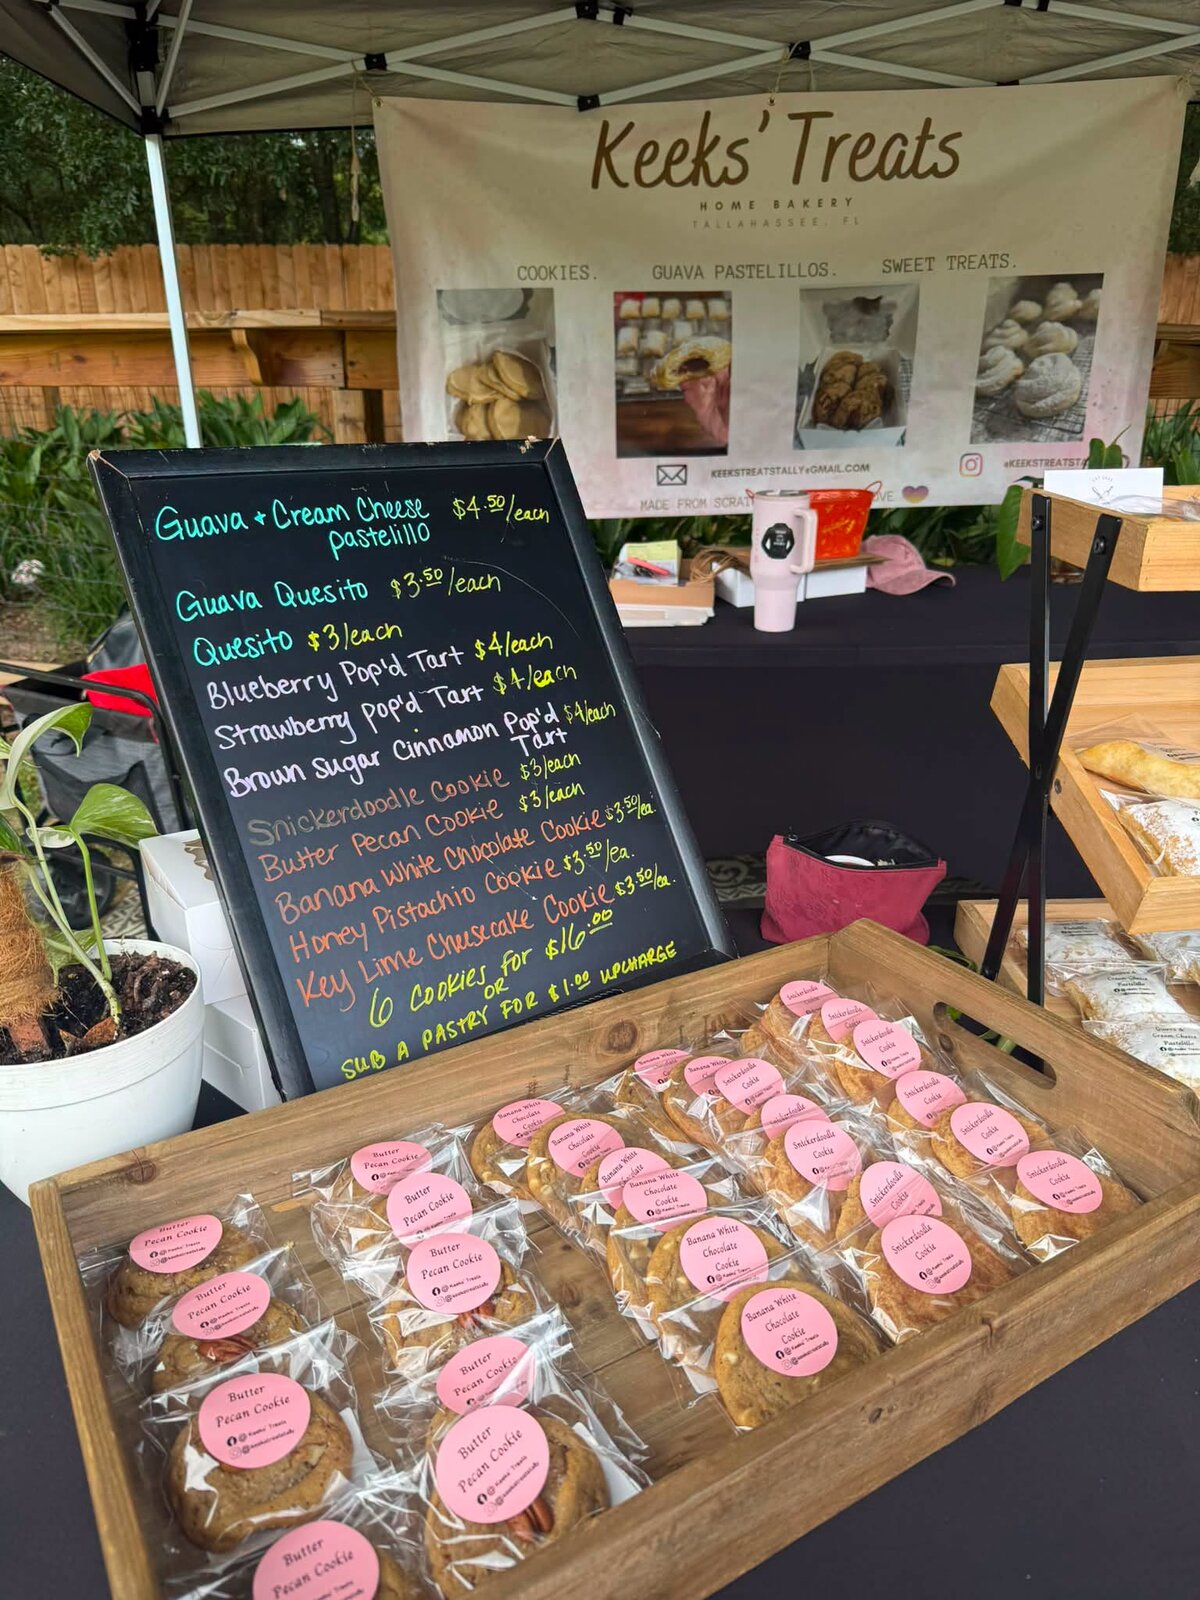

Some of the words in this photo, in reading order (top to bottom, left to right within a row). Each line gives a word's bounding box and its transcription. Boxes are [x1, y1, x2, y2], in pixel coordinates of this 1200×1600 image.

[591, 110, 769, 189] Keeks'
[787, 111, 963, 185] Treats
[700, 201, 755, 211] HOME
[773, 197, 853, 209] BAKERY
[842, 215, 860, 226] FL
[517, 265, 598, 281] COOKIES.
[652, 264, 704, 280] GUAVA
[714, 262, 837, 279] PASTELILLOS.
[882, 257, 935, 274] SWEET
[946, 253, 1017, 271] TREATS.
[640, 500, 670, 511] MADE
[677, 498, 707, 510] FROM
[155, 505, 248, 541] Guava
[272, 496, 352, 530] Cream
[356, 495, 431, 521] Cheese
[175, 589, 263, 623] Guava
[273, 577, 369, 608] Quesito
[193, 627, 294, 667] Quesito
[206, 673, 338, 711] Blueberry
[407, 645, 465, 671] Tart
[214, 711, 358, 750] Strawberry
[427, 684, 485, 709] Tart
[510, 727, 568, 756] Tart
[224, 763, 306, 799] Brown
[392, 721, 499, 762] Cinnamon
[247, 788, 423, 847] Snickerdoodle
[431, 767, 511, 803] Cookie
[258, 844, 340, 883] Butter
[351, 824, 422, 856] Pecan
[425, 798, 504, 836] Cookie
[275, 878, 381, 926] Banana
[381, 854, 443, 888] White
[443, 828, 536, 872] Chocolate
[540, 806, 607, 842] Cookie
[289, 920, 369, 963] Honey
[372, 886, 476, 936] Pistachio
[484, 857, 562, 895] Cookie
[296, 973, 356, 1013] Key
[357, 949, 424, 985] Lime
[426, 908, 535, 957] Cheesecake
[542, 883, 616, 925] Cookie
[368, 987, 394, 1029] 6
[410, 964, 487, 1013] Cookies
[484, 977, 509, 1001] OR
[340, 1052, 386, 1081] SUB
[396, 1040, 410, 1062] A
[421, 1003, 490, 1052] PASTRY
[501, 991, 539, 1020] FOR
[600, 941, 678, 985] UPCHARGE
[923, 1092, 942, 1105] Cookie
[497, 1108, 522, 1119] Banana
[522, 1101, 541, 1110] White
[511, 1110, 541, 1124] Chocolate
[551, 1131, 575, 1147] Banana
[574, 1121, 592, 1133] White
[567, 1132, 595, 1151] Chocolate
[792, 1129, 836, 1150] Snickerdoodle
[980, 1125, 999, 1140] Cookie
[363, 1160, 389, 1170] Pecan
[391, 1153, 420, 1165] Cookie
[372, 1148, 400, 1158] Butter
[581, 1144, 601, 1158] Cookie
[812, 1147, 834, 1159] Cookie
[601, 1163, 624, 1184] Banana
[1026, 1156, 1068, 1179] Snickerdoodle
[629, 1178, 657, 1188] Banana
[657, 1171, 680, 1181] White
[643, 1183, 678, 1196] Chocolate
[869, 1169, 904, 1208] Snickerdoodle
[1048, 1173, 1071, 1186] Cookie
[404, 1185, 432, 1205] Butter
[655, 1196, 679, 1207] Cookie
[890, 1190, 909, 1210] Cookie
[402, 1208, 429, 1227] Pecan
[428, 1191, 455, 1212] Cookie
[144, 1234, 173, 1247] Pecan
[176, 1224, 208, 1239] Cookie
[686, 1231, 716, 1246] Banana
[716, 1224, 740, 1235] White
[891, 1223, 933, 1255] Snickerdoodle
[428, 1242, 461, 1258] Butter
[702, 1241, 738, 1258] Chocolate
[914, 1243, 937, 1261] Cookie
[420, 1264, 450, 1280] Pecan
[452, 1252, 484, 1270] Cookie
[715, 1258, 740, 1271] Cookie
[187, 1302, 218, 1320] Pecan
[219, 1284, 252, 1304] Cookie
[194, 1281, 228, 1301] Butter
[745, 1303, 775, 1322] Banana
[774, 1292, 797, 1307] White
[765, 1310, 800, 1332] Chocolate
[781, 1326, 806, 1345] Cookie
[459, 1351, 492, 1376] Butter
[452, 1377, 485, 1397] Pecan
[485, 1355, 519, 1379] Cookie
[227, 1384, 267, 1403] Butter
[215, 1409, 251, 1428] Pecan
[253, 1394, 291, 1415] Cookie
[457, 1425, 493, 1460] Butter
[457, 1462, 491, 1494] Pecan
[488, 1427, 524, 1463] Cookie
[282, 1537, 325, 1568] Butter
[272, 1573, 312, 1599] Pecan
[314, 1550, 355, 1577] Cookie
